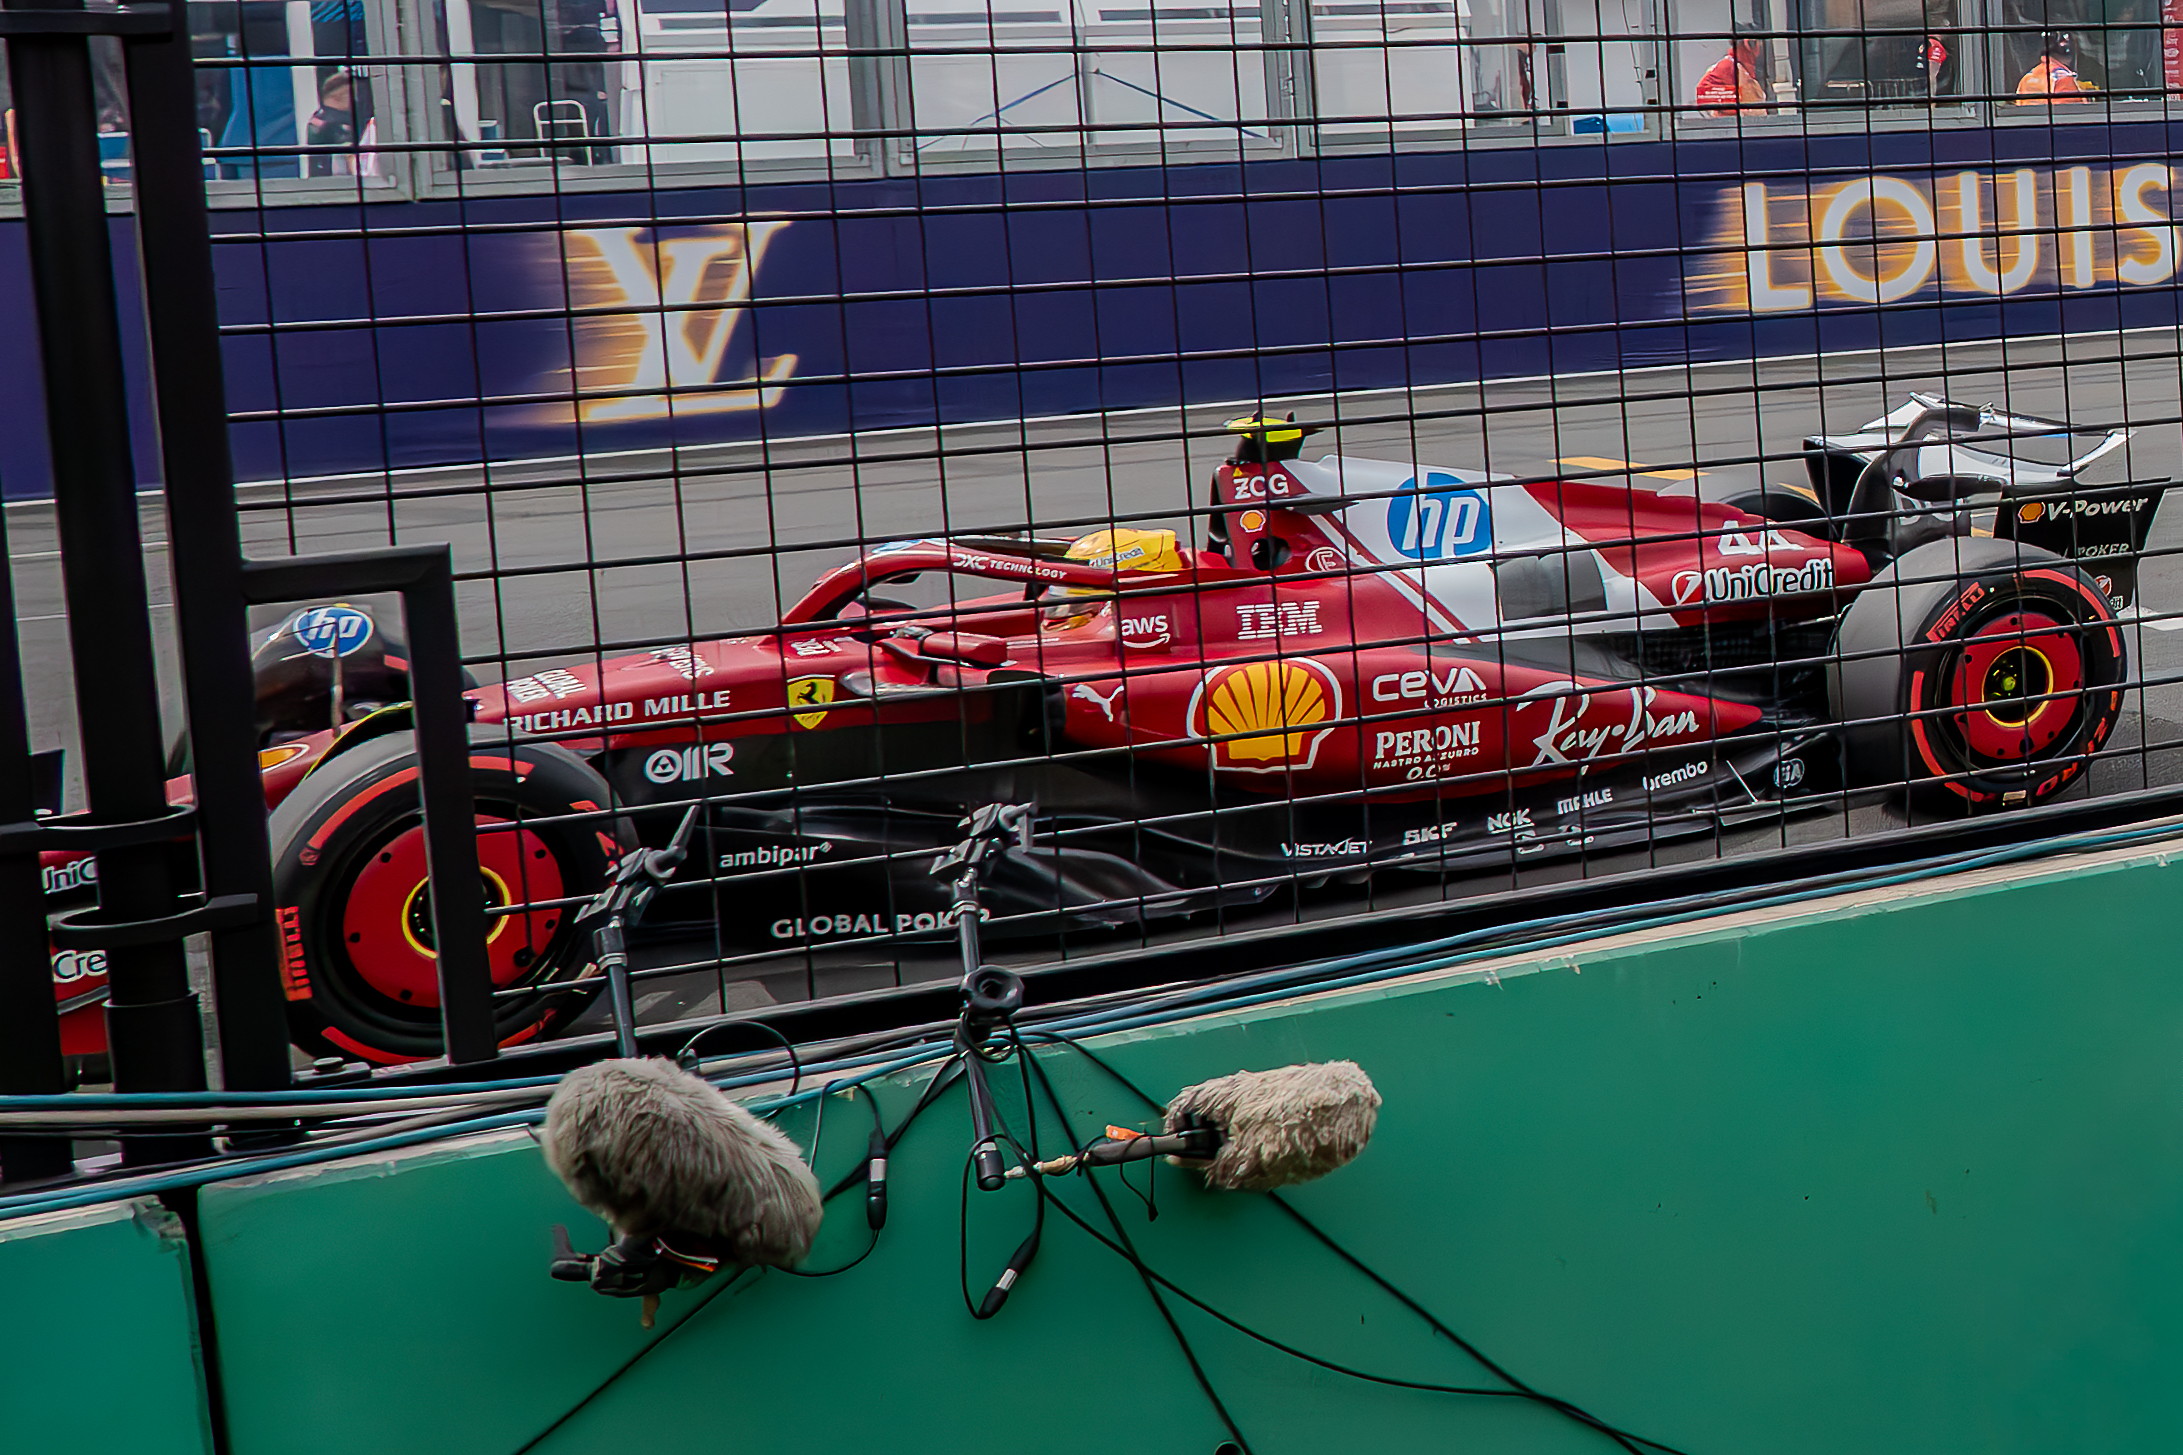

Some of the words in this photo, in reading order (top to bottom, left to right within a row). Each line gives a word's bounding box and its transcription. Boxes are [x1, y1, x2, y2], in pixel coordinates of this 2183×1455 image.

[1742, 163, 2181, 312] LOUIS
[1398, 473, 1484, 557] hp
[1718, 520, 1804, 556] 44
[1706, 558, 1834, 600] UniCredit
[1121, 615, 1169, 637] aws
[1236, 600, 1323, 640] IBM
[503, 702, 634, 733] RICHARD
[644, 690, 731, 717] MILLE
[1373, 756, 1421, 770] NASTRO
[1424, 746, 1479, 763] AZURRO
[1375, 720, 1481, 760] PERONI
[1643, 761, 1708, 791] brembo
[1403, 822, 1458, 846] SKF
[720, 845, 820, 868] ambipar
[770, 914, 889, 939] GLOBAL
[896, 908, 990, 932] POK
